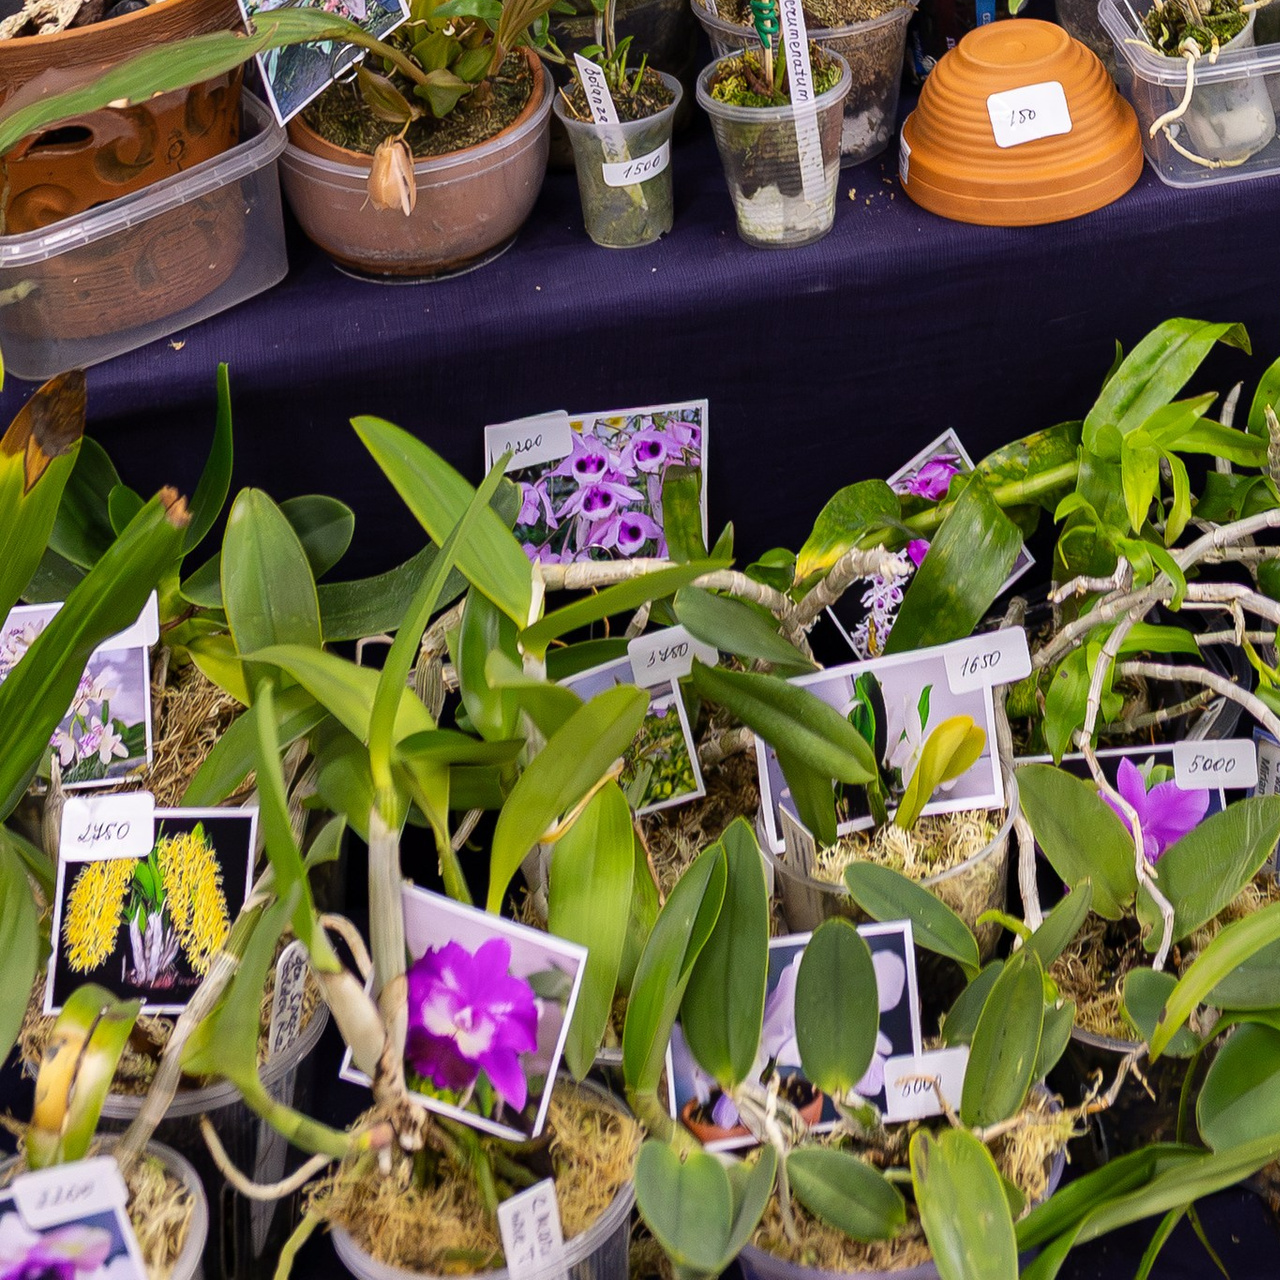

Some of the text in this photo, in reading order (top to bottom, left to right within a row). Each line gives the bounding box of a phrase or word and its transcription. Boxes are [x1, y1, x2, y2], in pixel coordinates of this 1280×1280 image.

[1010, 108, 1037, 127] 150
[622, 153, 662, 179] 1500
[961, 650, 1001, 678] 1650
[1188, 754, 1236, 774] 5000
